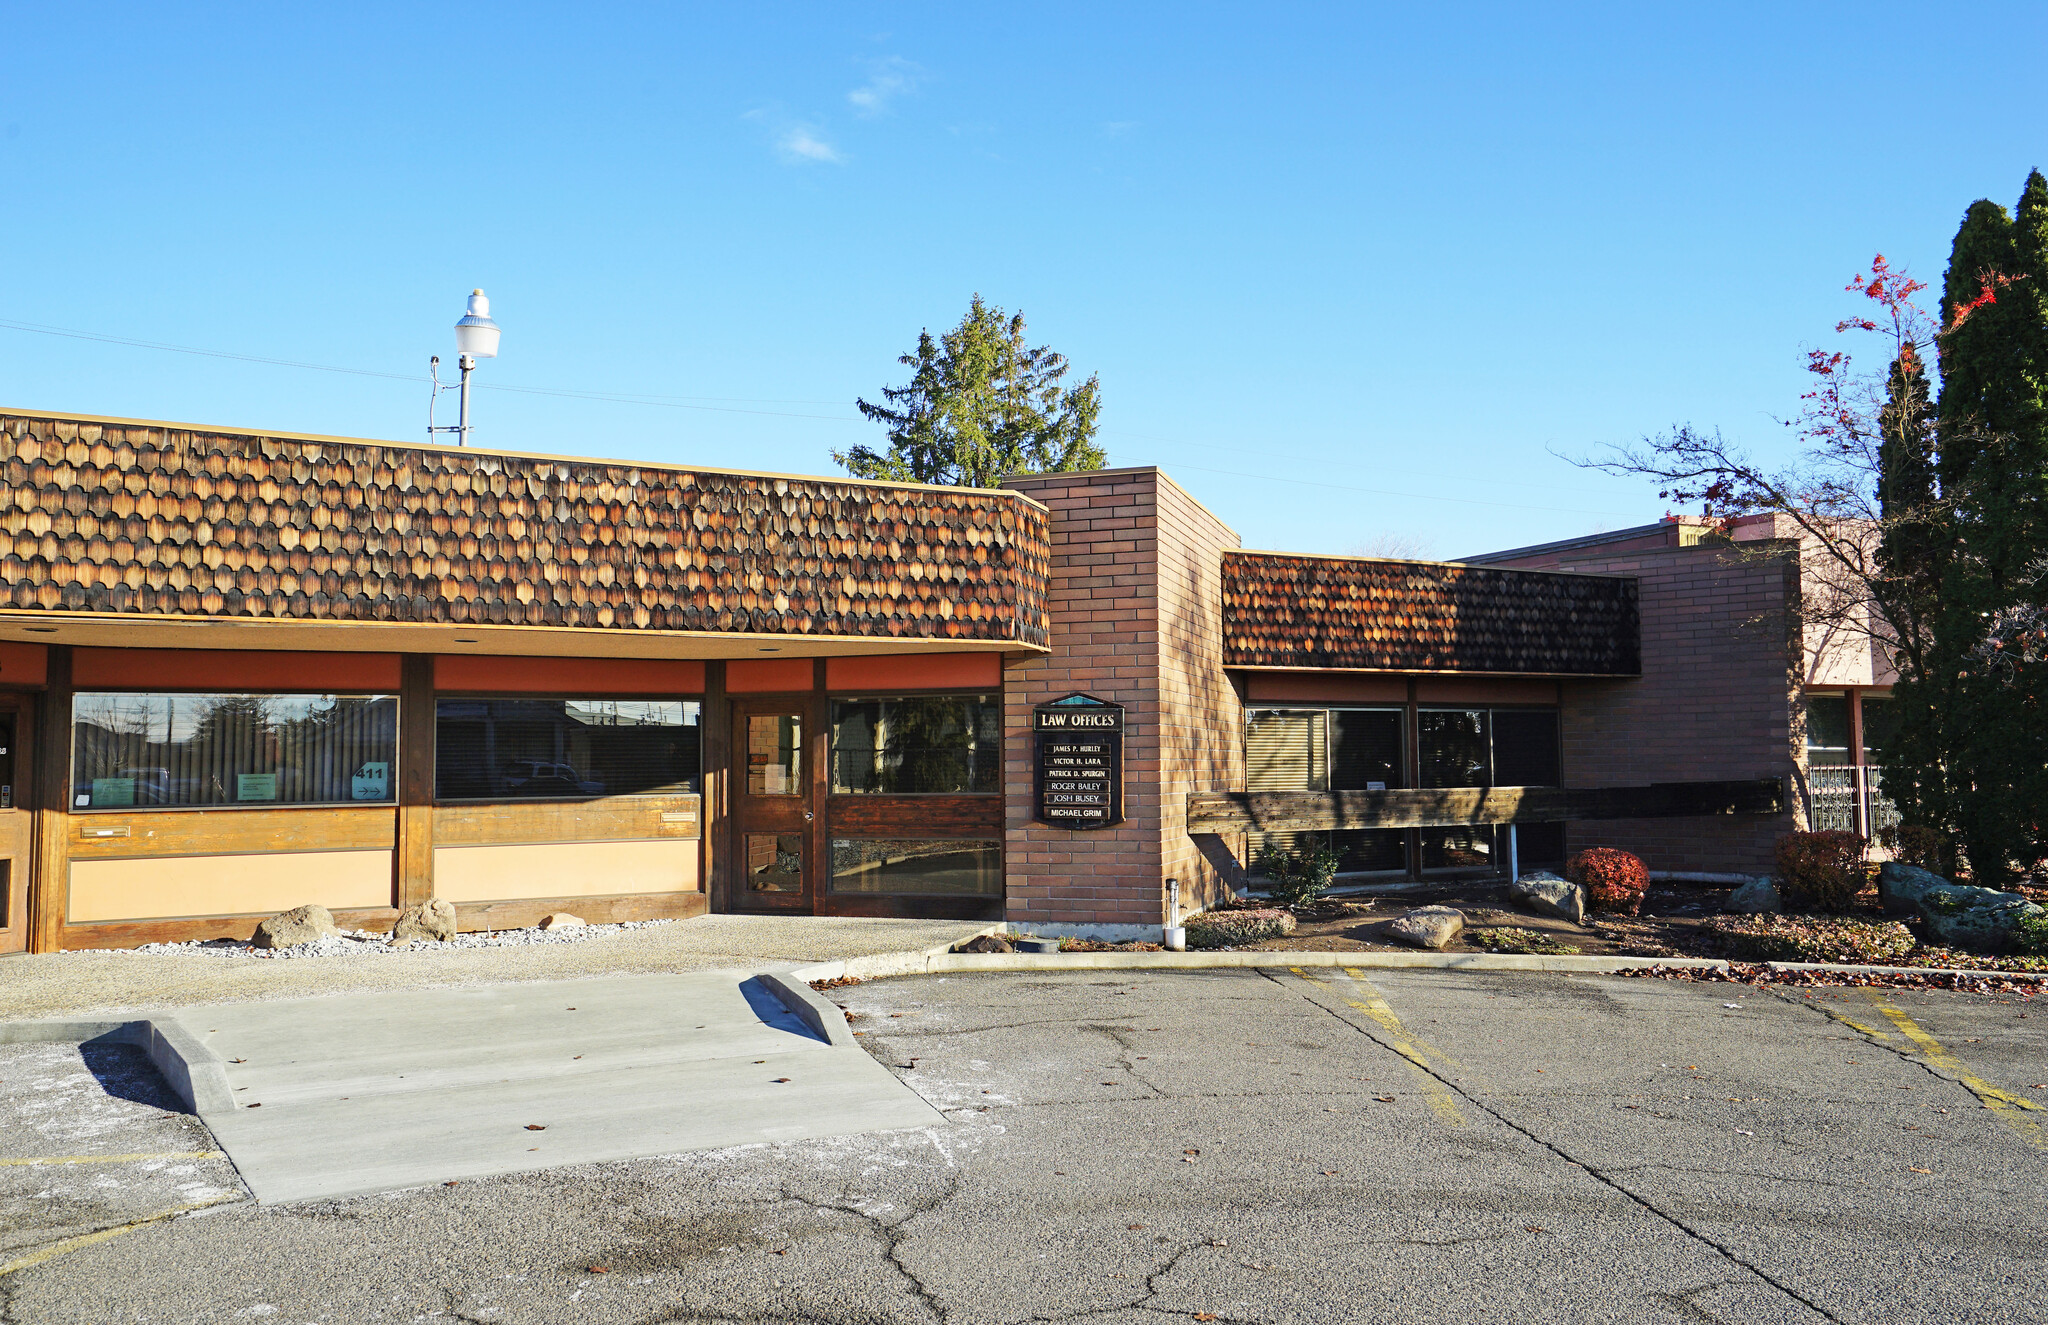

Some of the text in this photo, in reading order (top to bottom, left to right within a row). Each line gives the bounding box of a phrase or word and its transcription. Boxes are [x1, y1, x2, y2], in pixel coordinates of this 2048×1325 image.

[1042, 714, 1114, 726] LAW OFFICES
[355, 768, 382, 779] 411
[1051, 809, 1102, 817] MICHAEL GRIM
